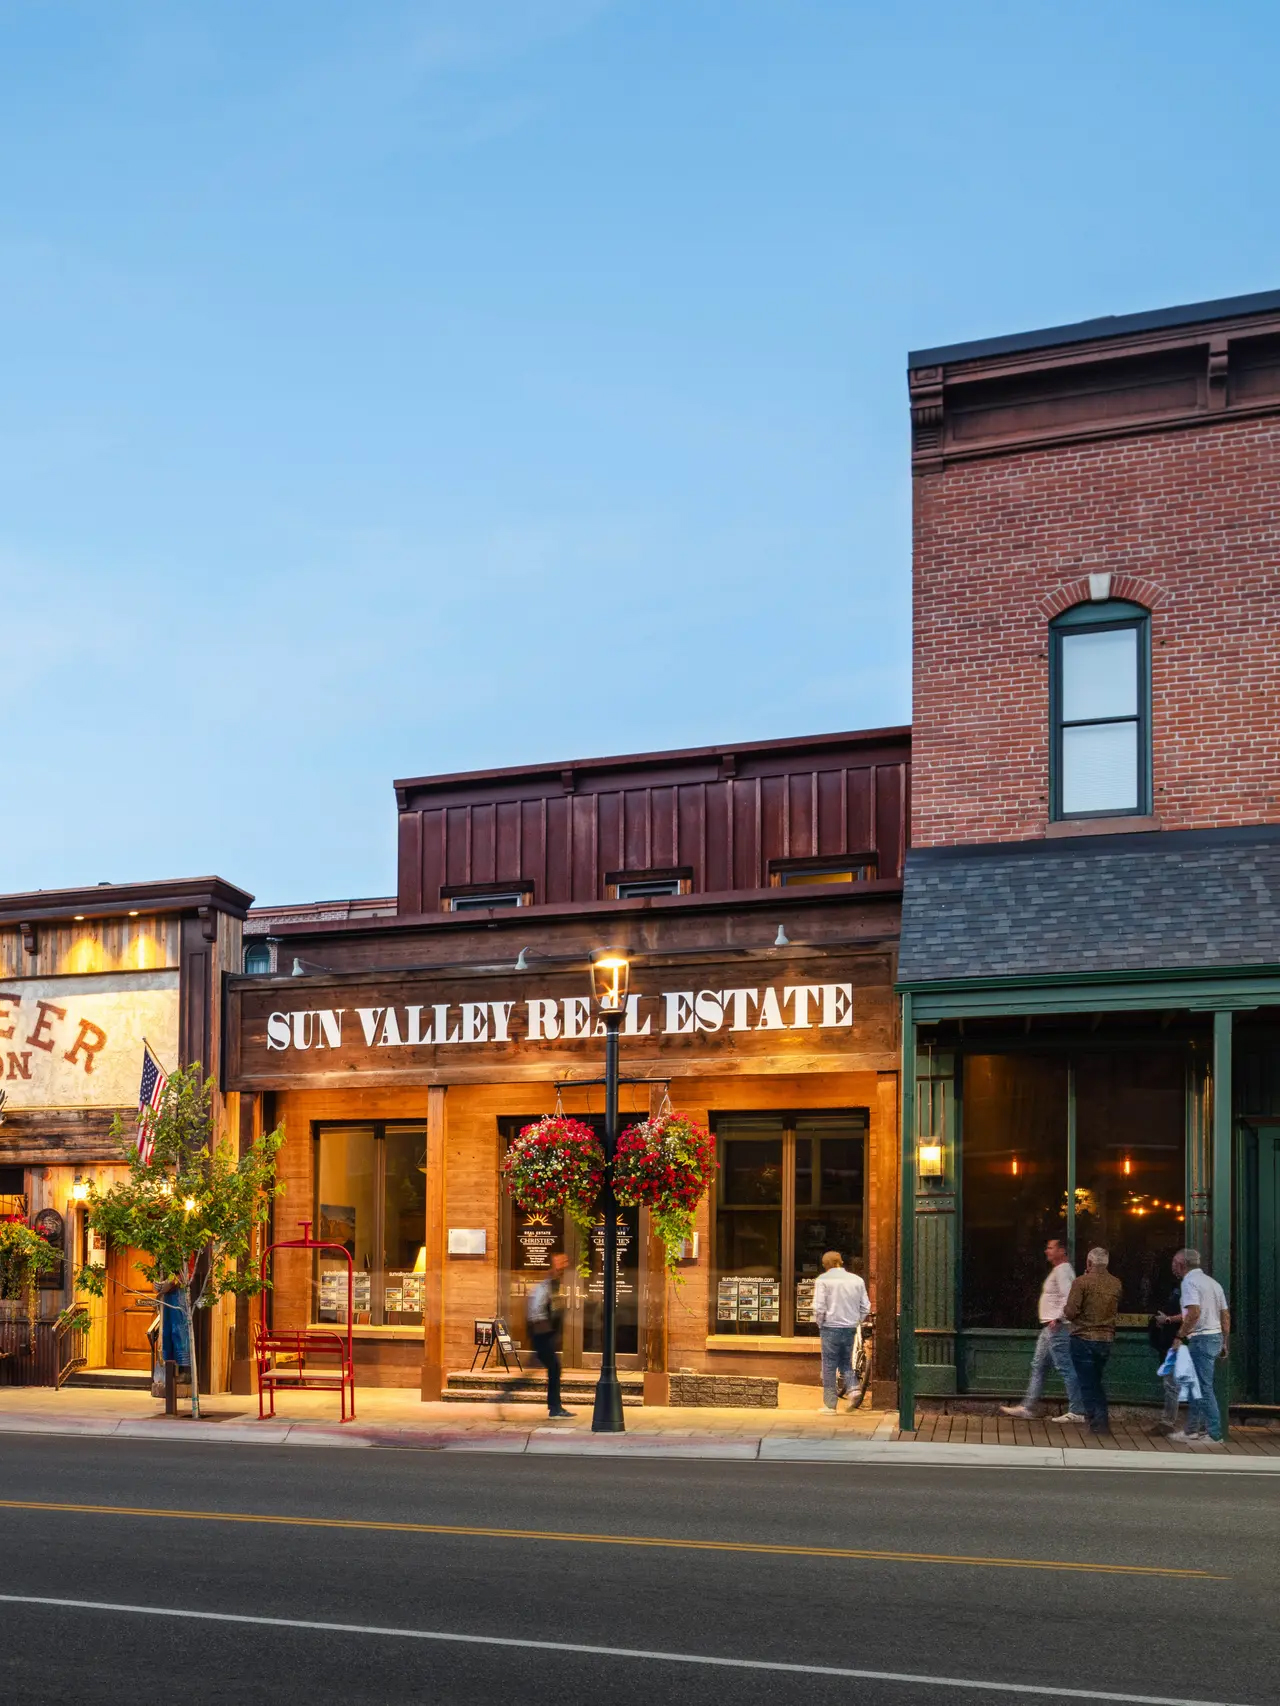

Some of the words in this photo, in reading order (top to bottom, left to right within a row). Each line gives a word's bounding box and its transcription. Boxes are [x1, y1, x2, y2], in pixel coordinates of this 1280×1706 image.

[267, 1008, 345, 1050] SUN
[355, 1001, 516, 1047] VALLEY
[524, 993, 651, 1041] REAL
[661, 983, 853, 1035] ESTATE
